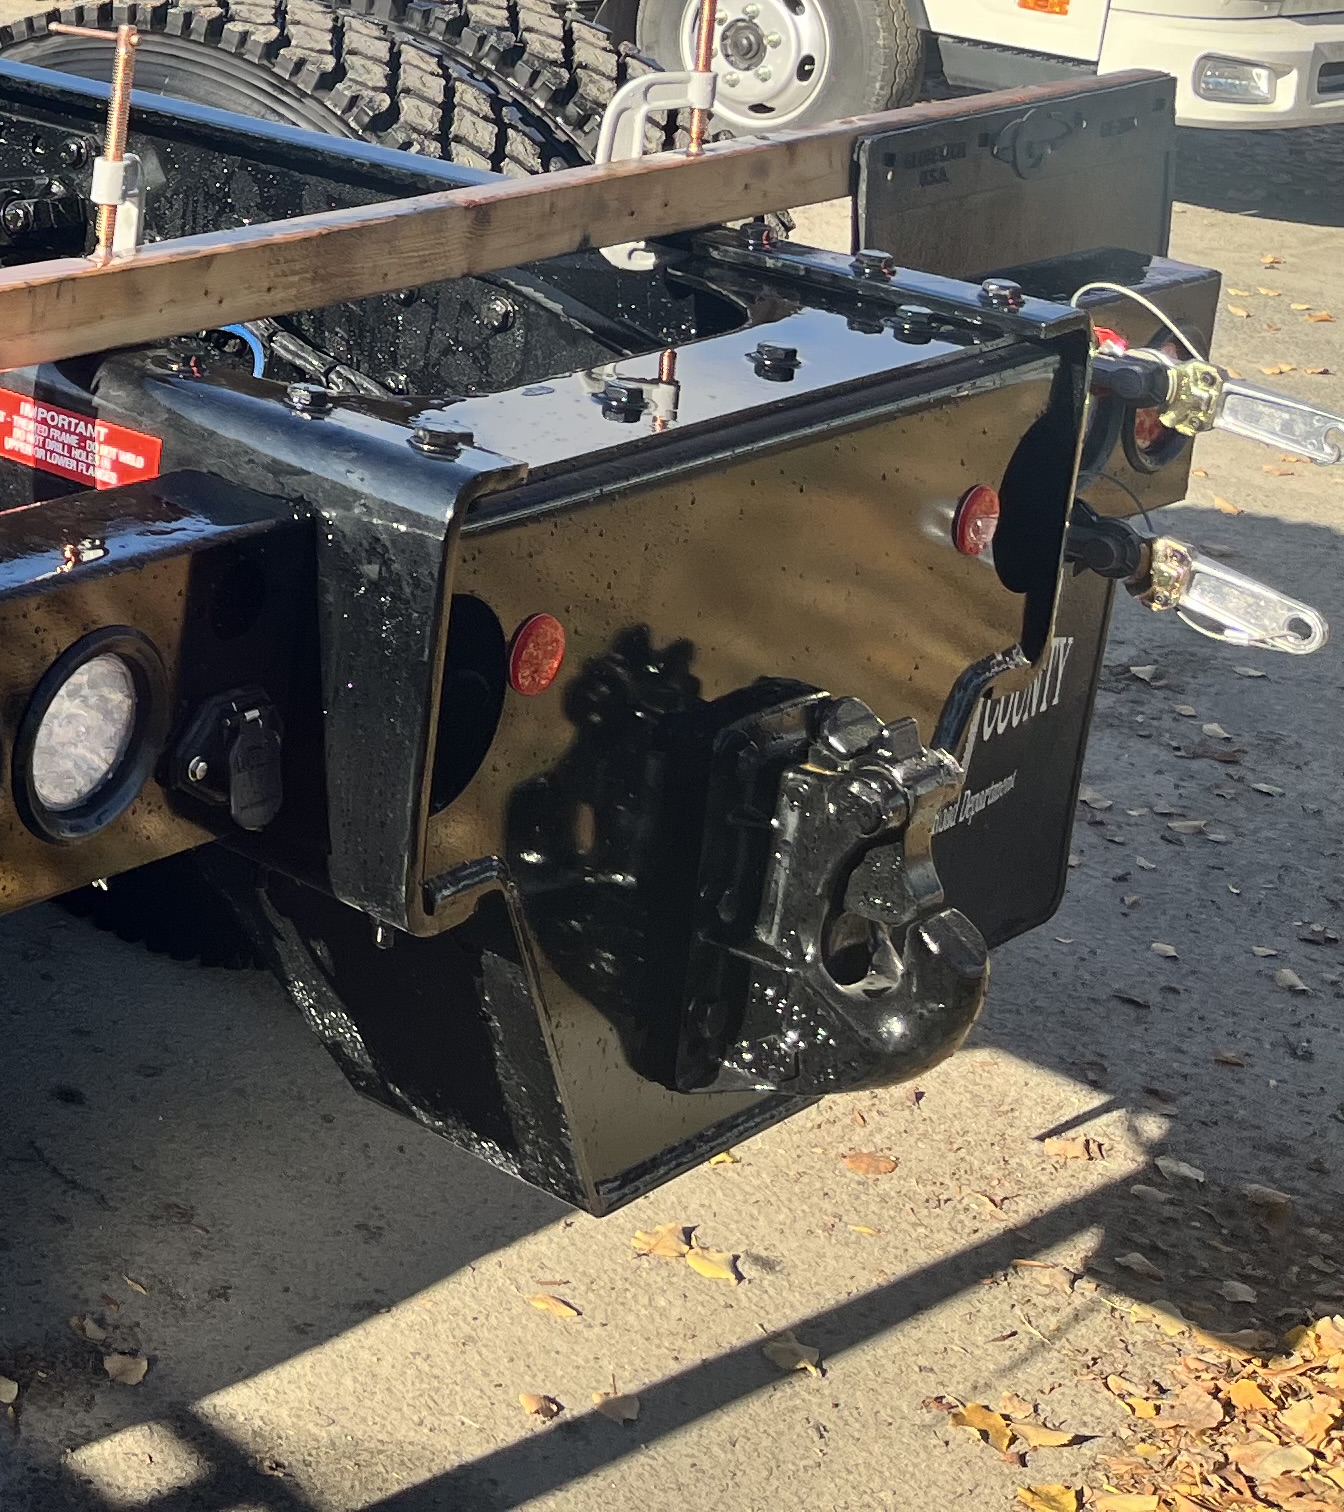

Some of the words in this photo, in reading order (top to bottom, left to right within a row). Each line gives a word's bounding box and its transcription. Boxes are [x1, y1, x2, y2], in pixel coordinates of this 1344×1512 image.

[12, 415, 49, 437] TREATED
[50, 427, 80, 447] FRAME
[86, 439, 99, 454] DO
[99, 444, 118, 460] NOT
[19, 401, 109, 442] IMPORTANT
[3, 436, 34, 457] UPPER
[34, 446, 45, 460] OR
[47, 451, 77, 472] LOWER
[78, 462, 118, 485] FLANGES
[12, 427, 26, 441] DO
[27, 431, 44, 447] NOT
[45, 438, 69, 457] DRILL
[71, 446, 99, 467] HOLES
[100, 456, 112, 469] IN
